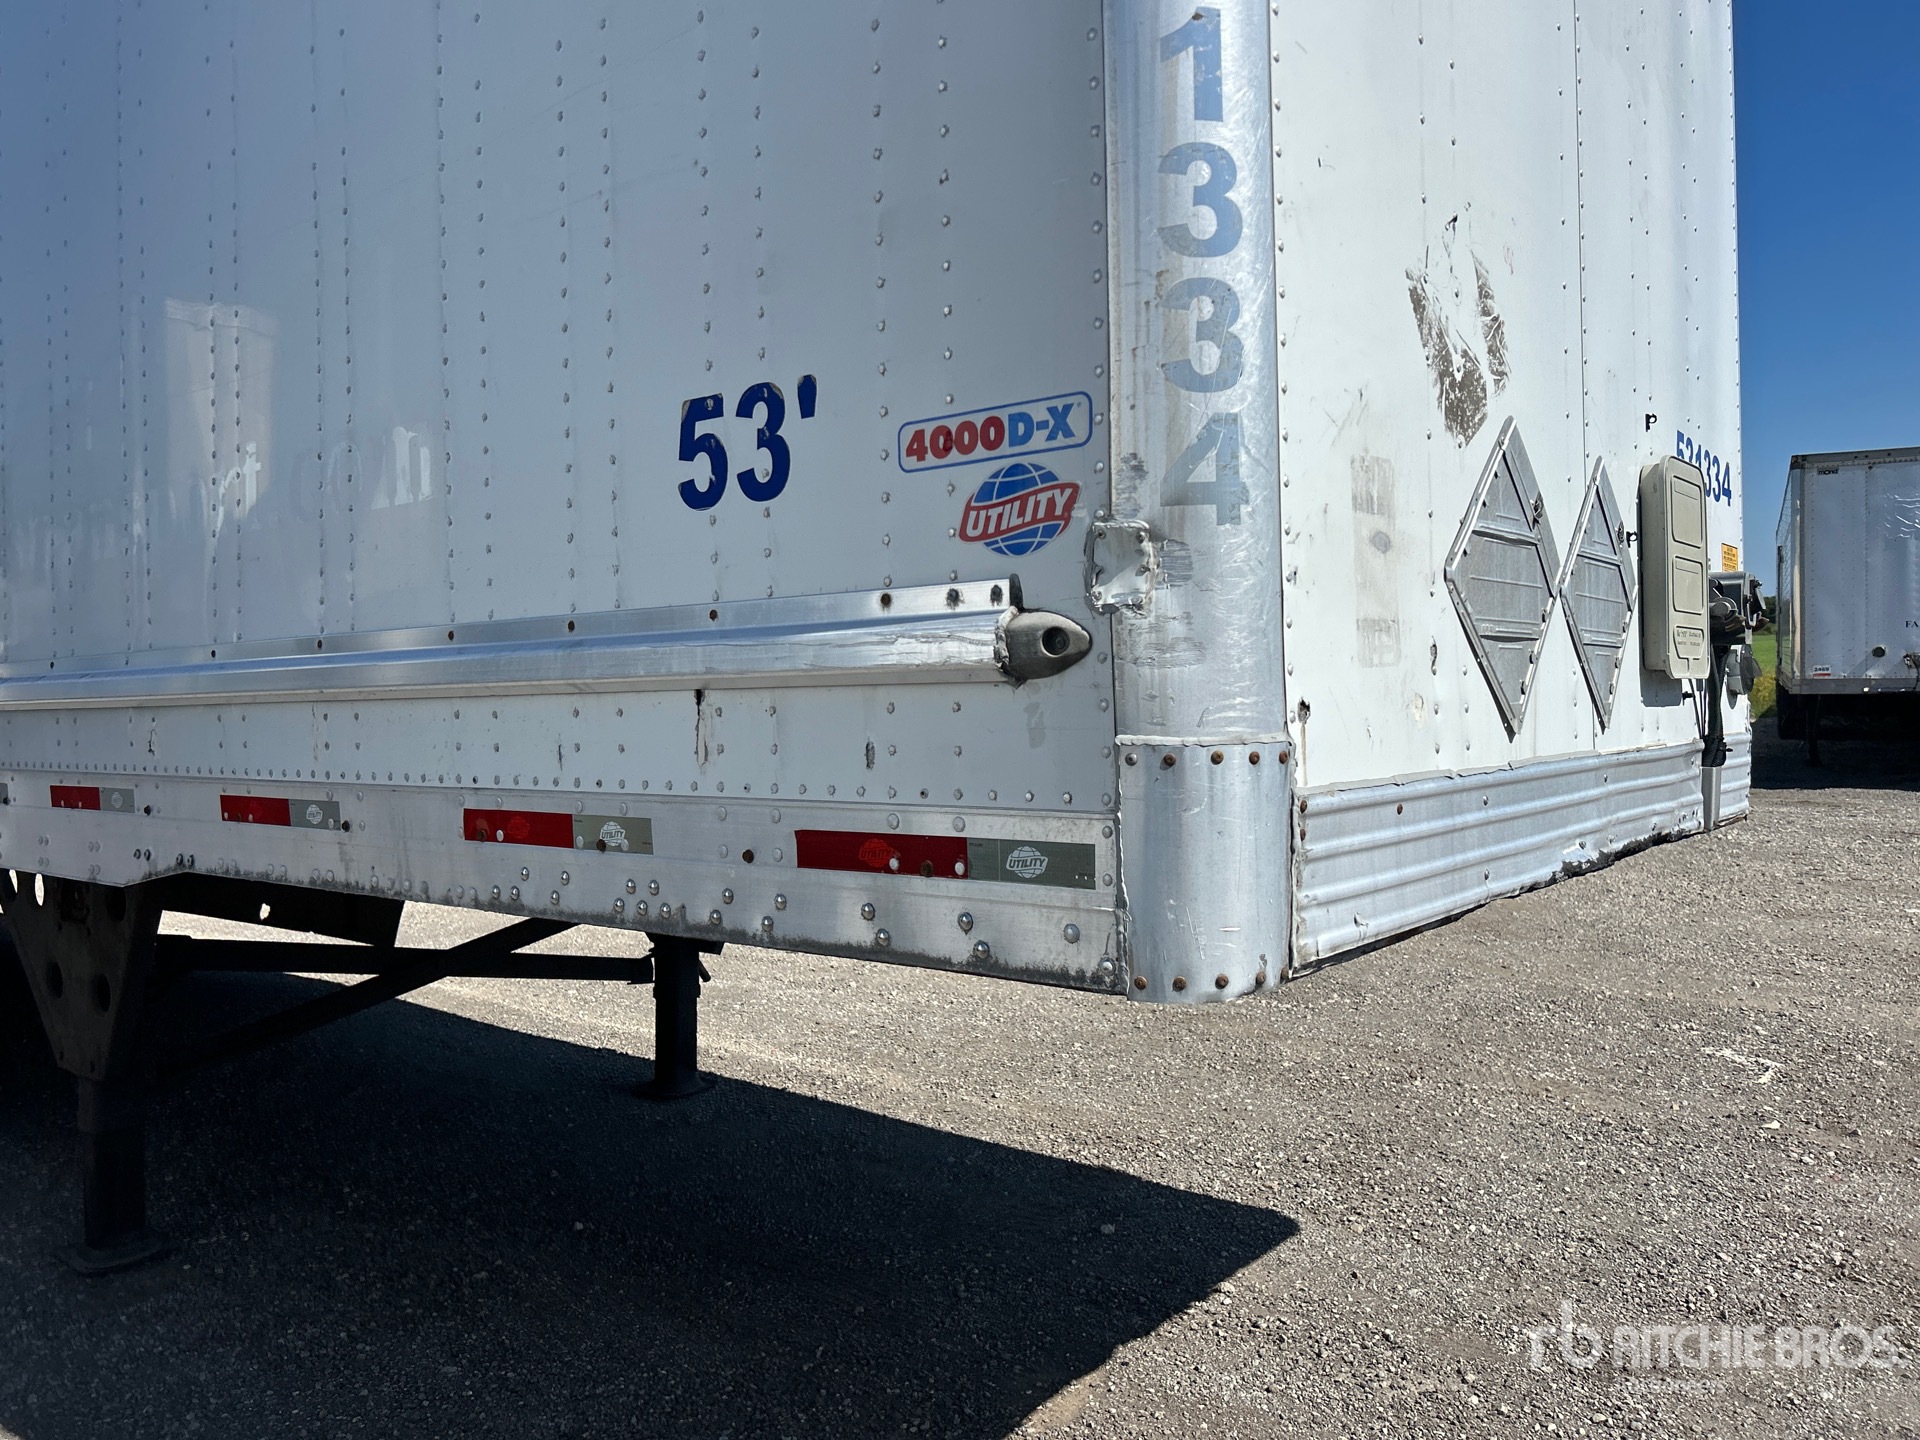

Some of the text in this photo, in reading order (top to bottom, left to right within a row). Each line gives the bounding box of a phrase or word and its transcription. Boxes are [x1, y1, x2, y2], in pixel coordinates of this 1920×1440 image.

[677, 374, 818, 511] 53'
[905, 402, 1076, 462] 4000D-X
[966, 489, 1076, 538] UTILITY
[601, 830, 625, 839] UTILITY
[1008, 858, 1046, 869] UTILITY
